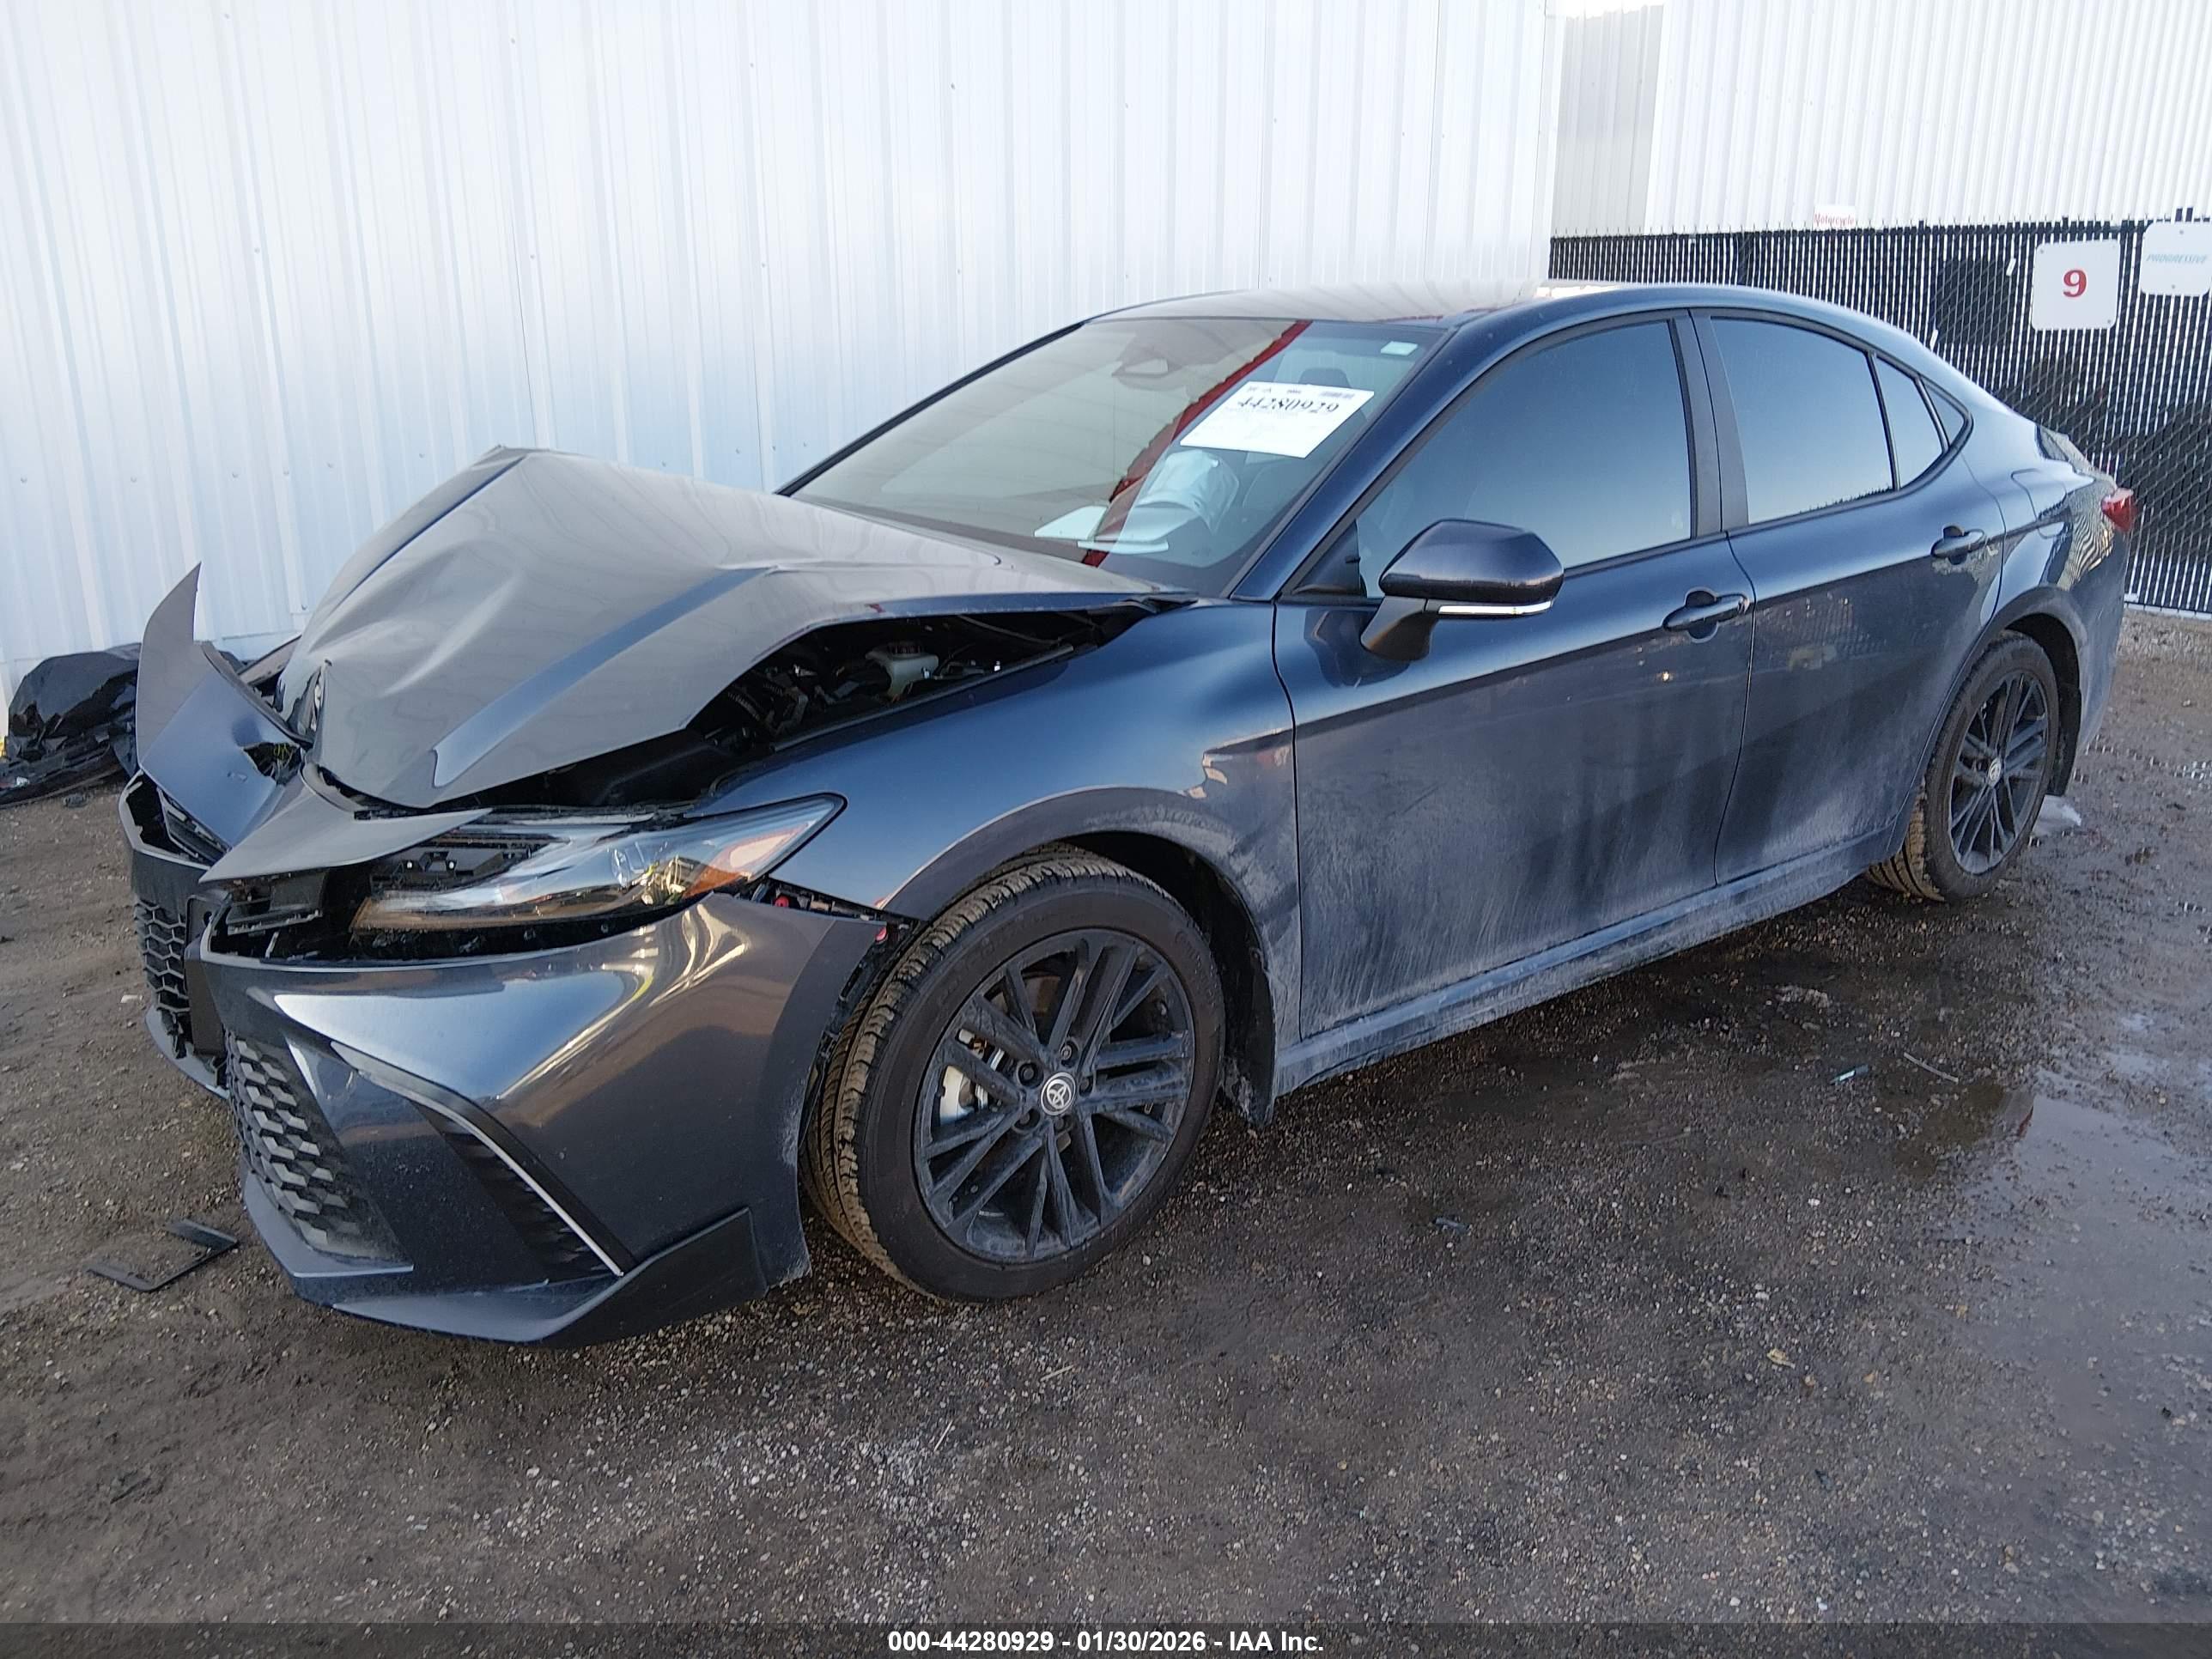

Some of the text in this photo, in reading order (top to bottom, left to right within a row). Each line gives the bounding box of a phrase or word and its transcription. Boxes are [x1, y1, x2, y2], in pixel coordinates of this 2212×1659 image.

[1814, 213, 1855, 227] Motorcycle
[2063, 269, 2087, 297] 9
[1237, 397, 1340, 414] 44280929
